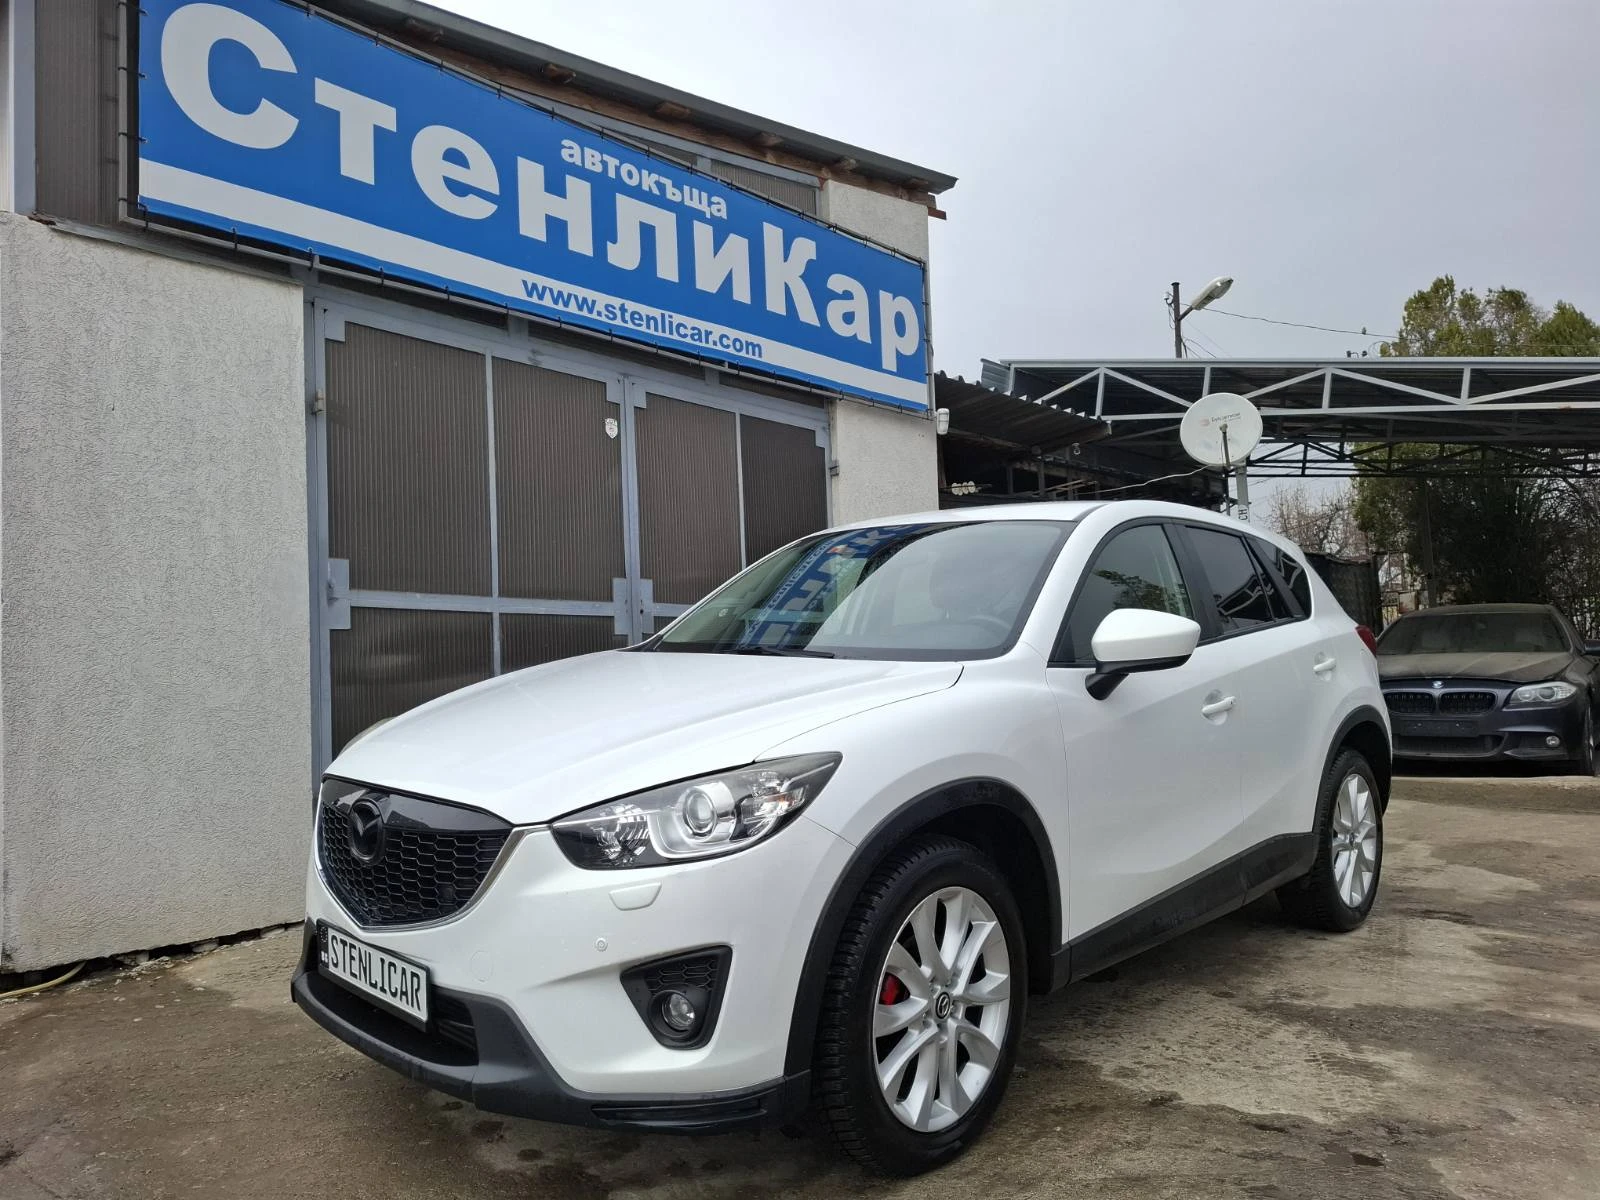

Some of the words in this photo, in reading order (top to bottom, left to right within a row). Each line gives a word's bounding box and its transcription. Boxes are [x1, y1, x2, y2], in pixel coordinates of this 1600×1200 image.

[161, 3, 920, 372] СтенлиКар
[560, 139, 728, 220] автокъща
[521, 279, 763, 358] www.stenlicar.com
[330, 934, 422, 1012] STENLICAR
